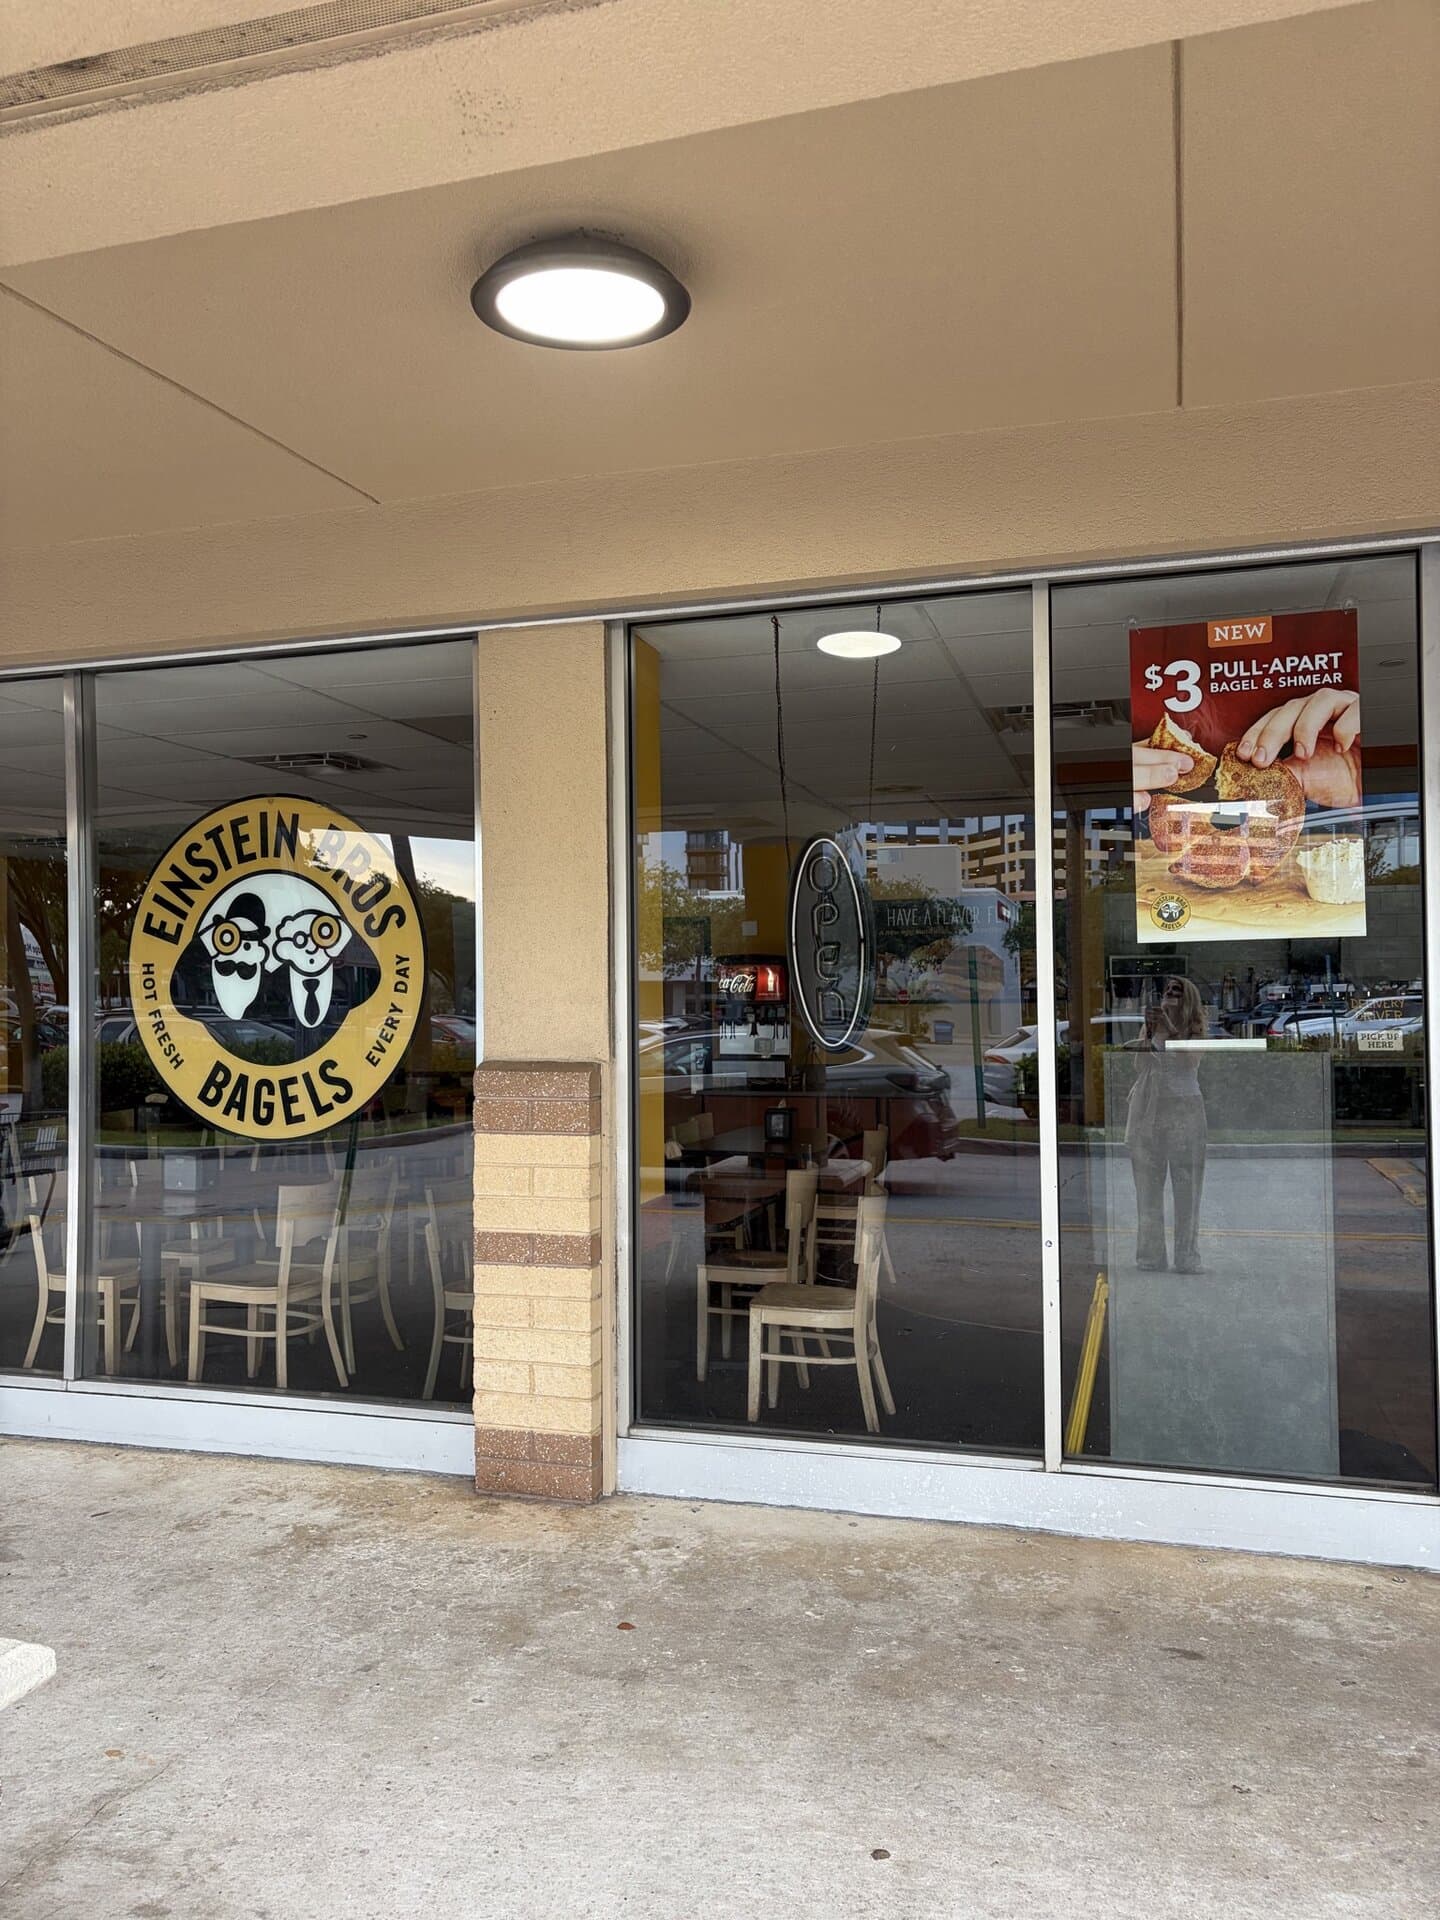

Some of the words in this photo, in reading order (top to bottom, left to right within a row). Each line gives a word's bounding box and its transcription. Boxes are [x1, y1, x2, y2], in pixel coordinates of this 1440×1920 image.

[1214, 622, 1266, 642] NEW
[1210, 652, 1343, 679] PULL-APART
[1210, 680, 1258, 693] BAGEL
[1263, 678, 1274, 689] &
[1279, 672, 1343, 688] SHMEAR
[1144, 659, 1203, 713] $3
[143, 810, 299, 946] EINSTEIN
[312, 823, 406, 938] BROS
[887, 906, 919, 927] HAVE
[922, 904, 932, 926] A
[936, 904, 980, 926] FLAVOR
[142, 962, 157, 1001] HOT
[365, 1002, 404, 1068] EVERY
[397, 954, 411, 994] DAY
[148, 1010, 185, 1070] FRESH
[1361, 1033, 1384, 1041] PICK
[1387, 1032, 1400, 1041] UP
[198, 1059, 353, 1127] BAGELS
